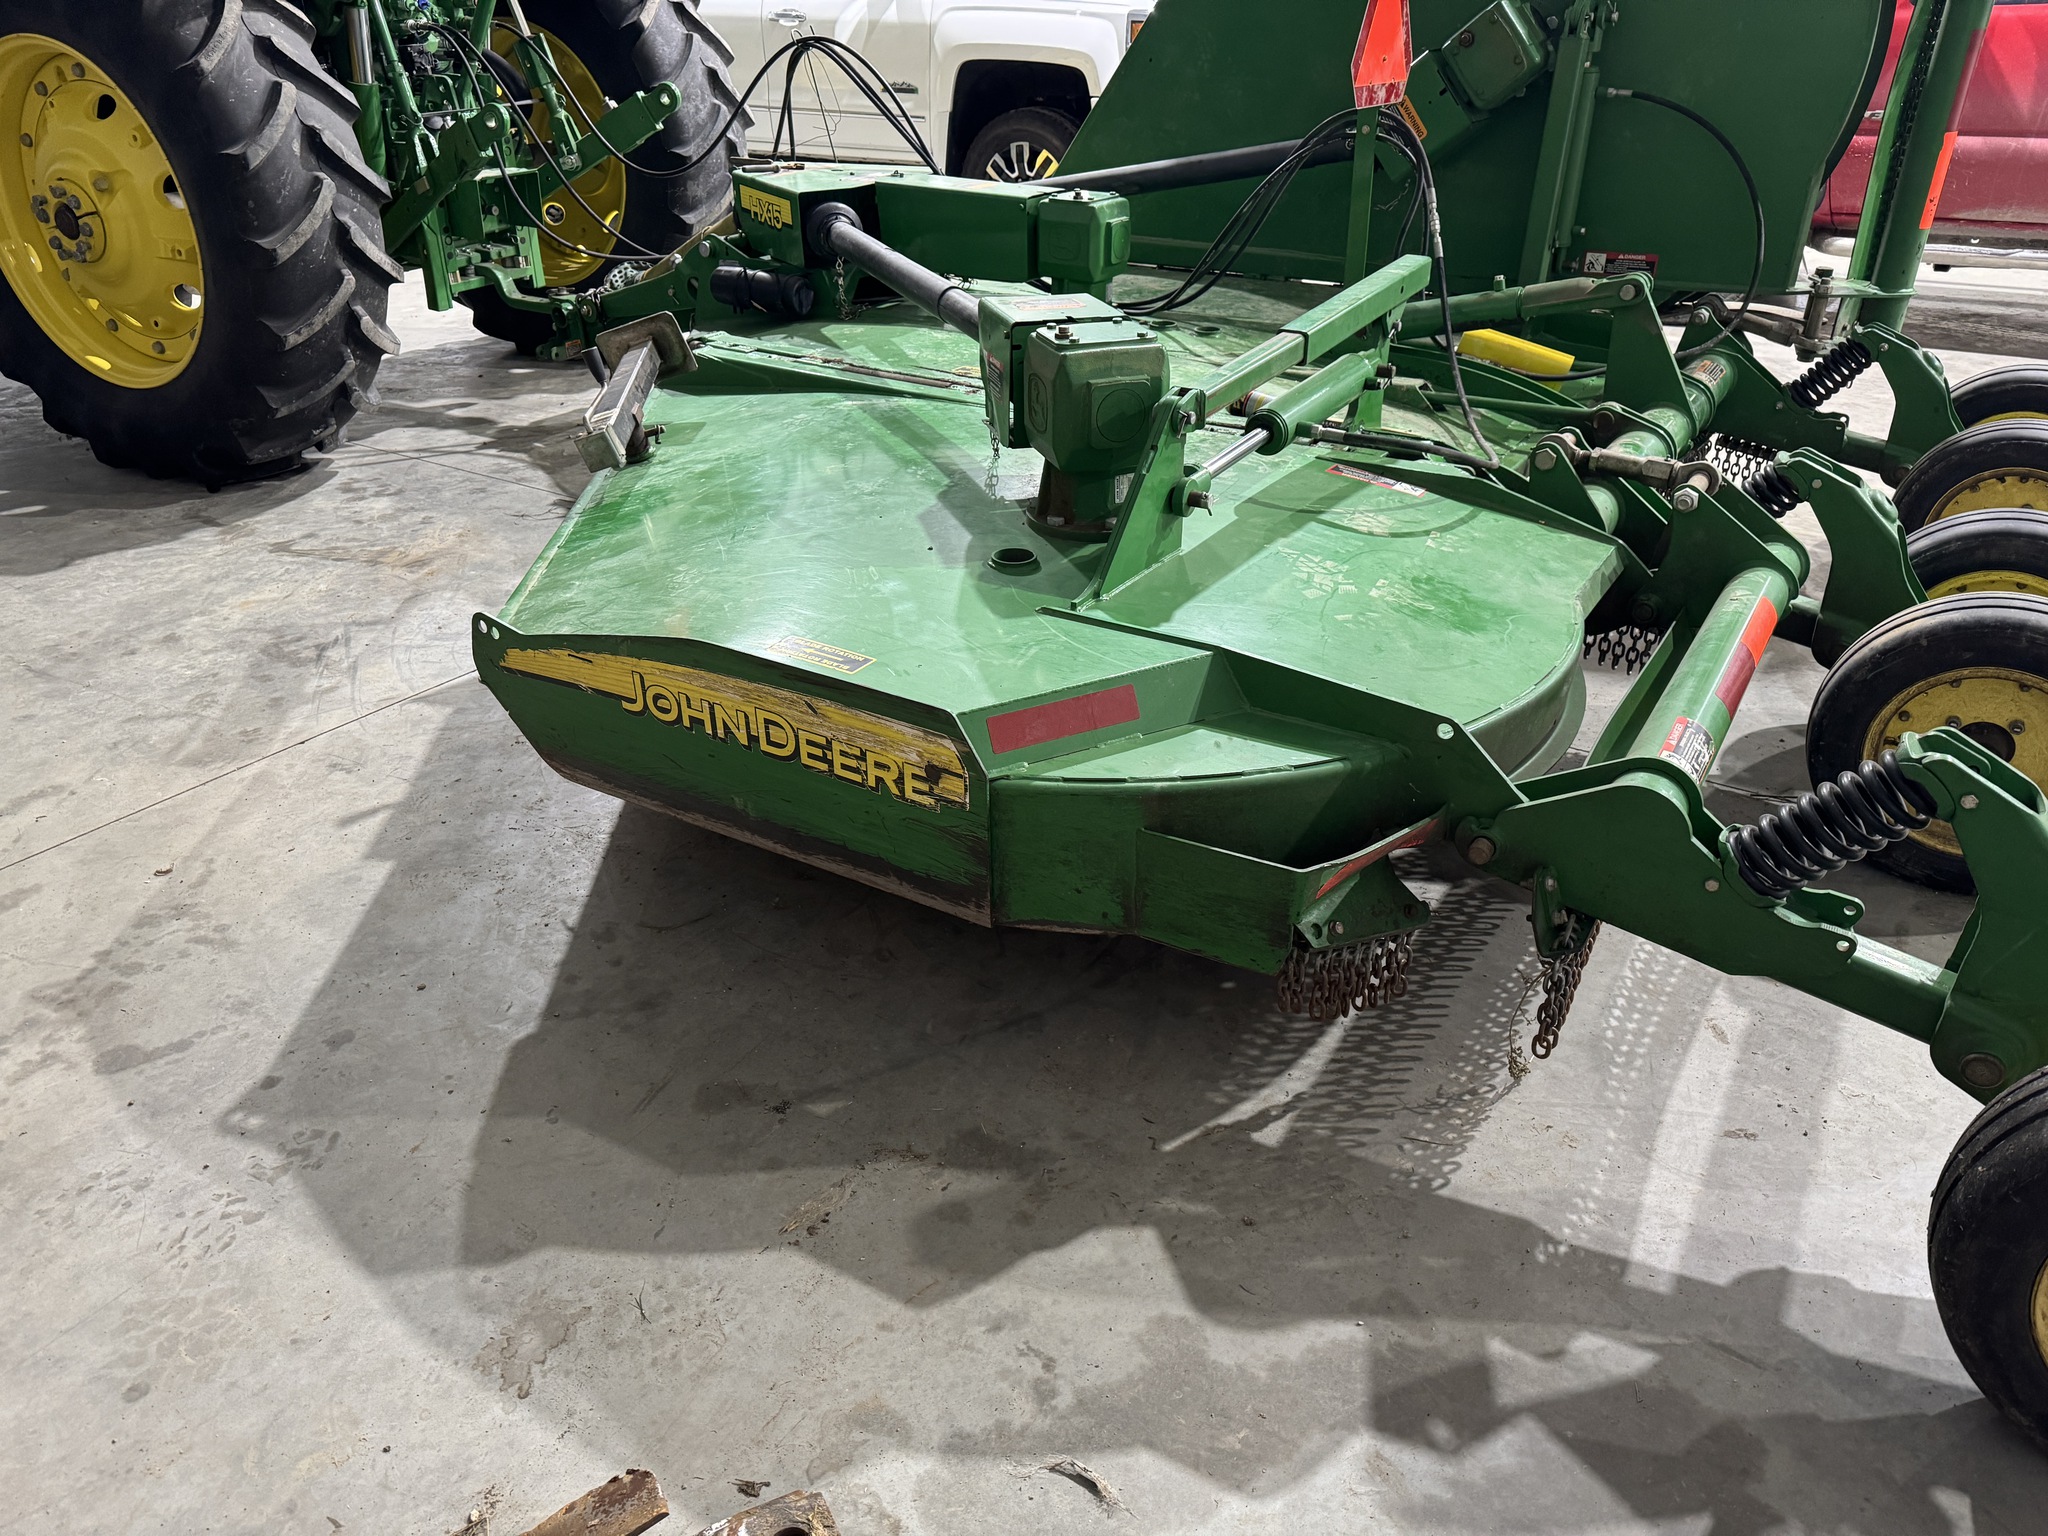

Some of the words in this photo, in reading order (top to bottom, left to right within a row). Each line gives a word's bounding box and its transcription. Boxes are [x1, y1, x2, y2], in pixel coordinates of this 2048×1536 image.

[1403, 104, 1424, 138] WARNING
[749, 195, 783, 229] HX15
[822, 645, 865, 662] ROTATION
[621, 671, 753, 751] JOHN
[754, 707, 942, 811] DEERE
